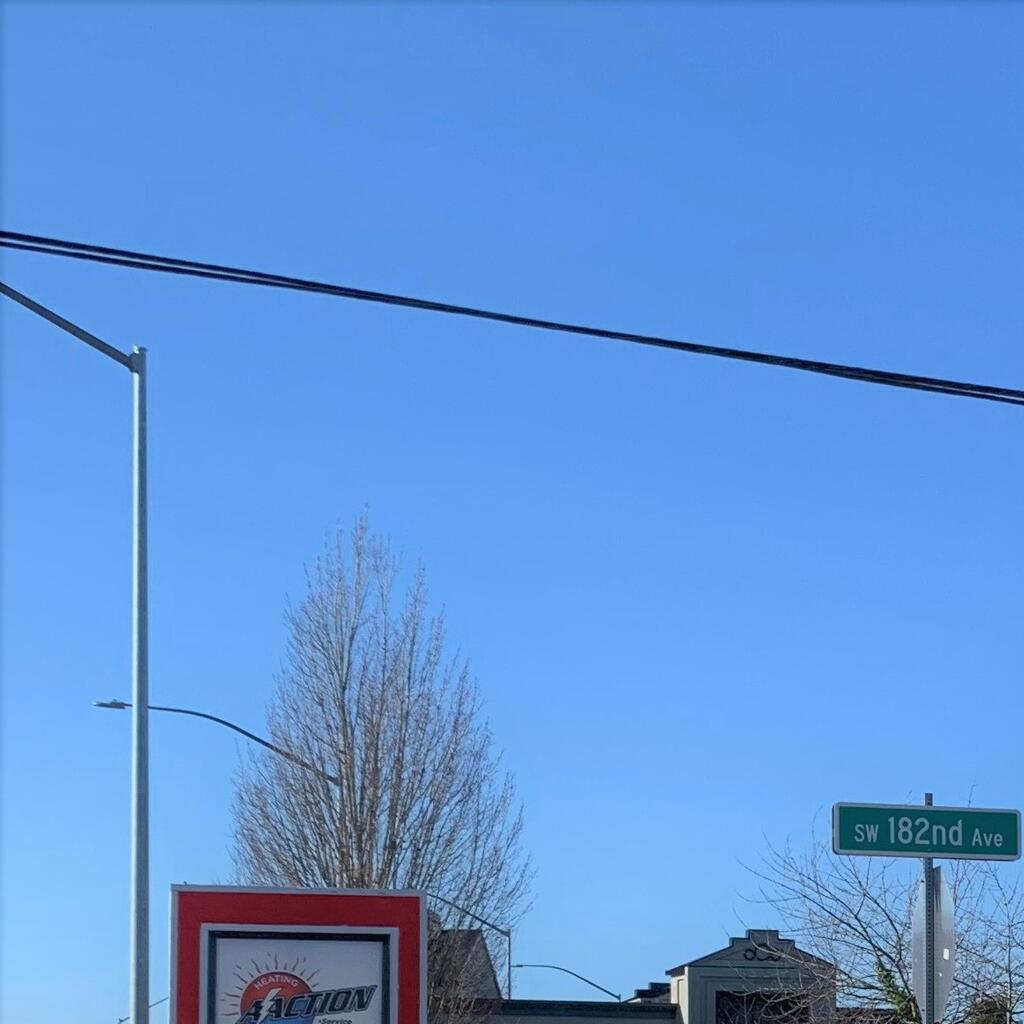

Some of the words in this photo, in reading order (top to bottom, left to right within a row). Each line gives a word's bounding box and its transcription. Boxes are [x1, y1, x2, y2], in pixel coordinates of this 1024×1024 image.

[854, 823, 879, 843] SW
[888, 816, 963, 847] 182nd
[971, 827, 1003, 847] Ave
[254, 974, 300, 990] HEATING
